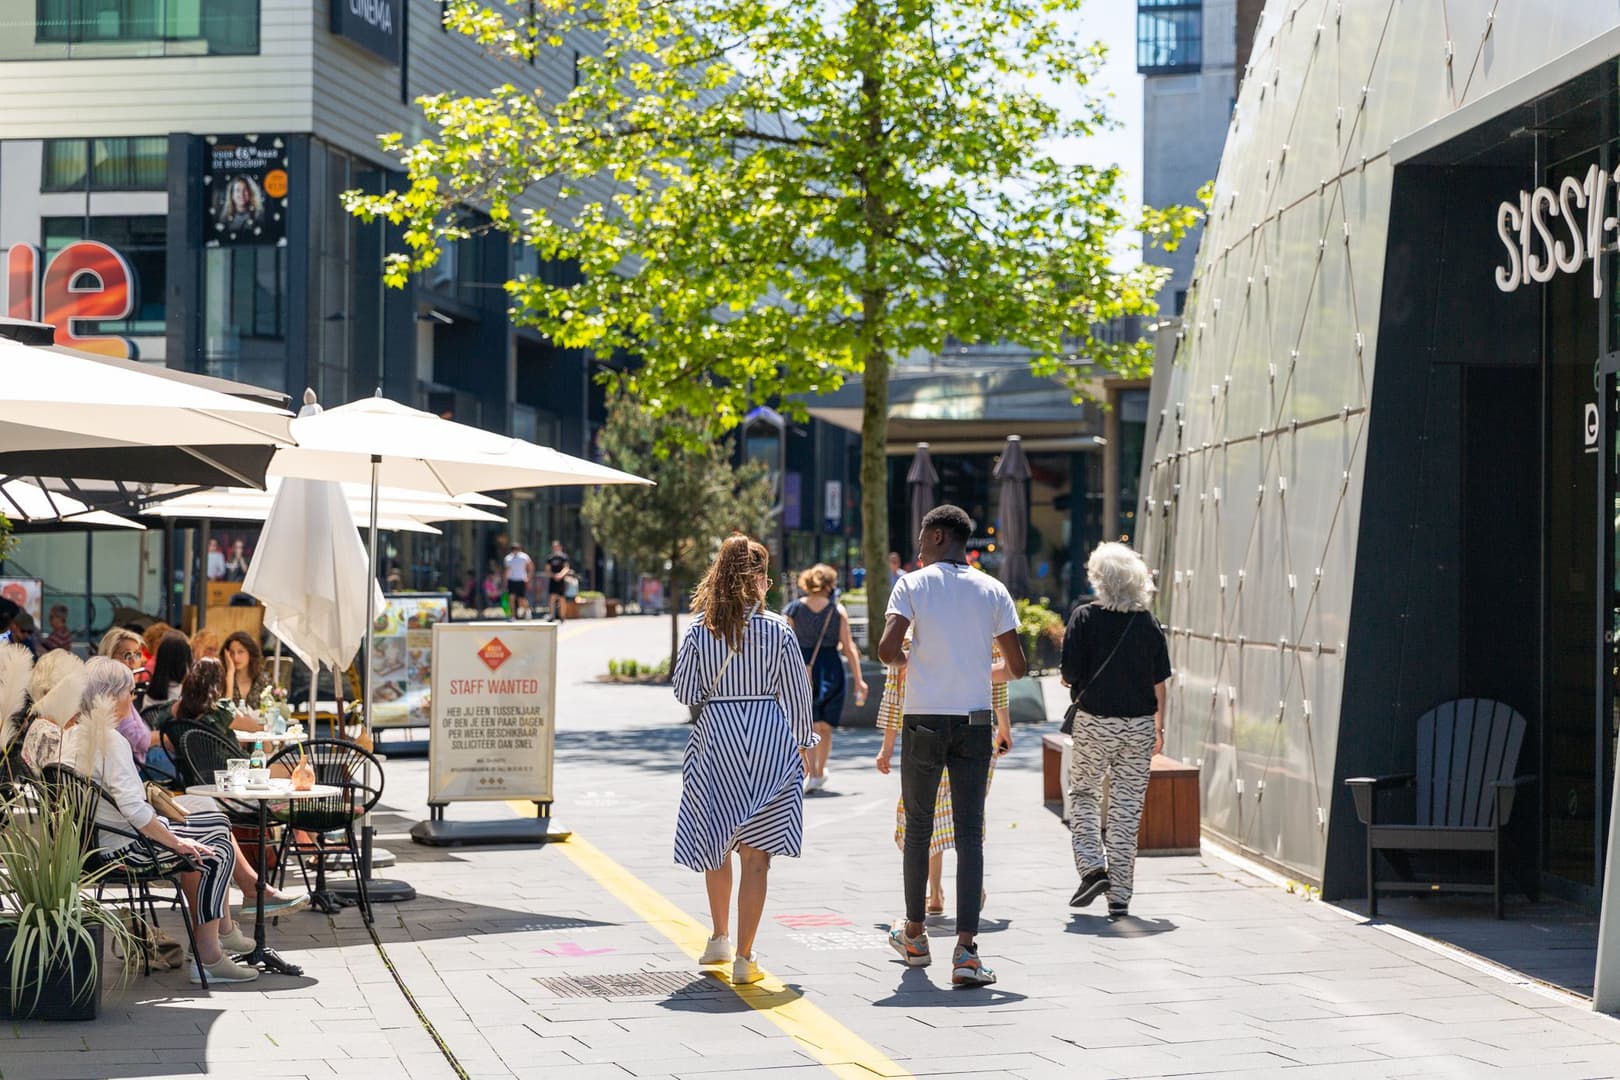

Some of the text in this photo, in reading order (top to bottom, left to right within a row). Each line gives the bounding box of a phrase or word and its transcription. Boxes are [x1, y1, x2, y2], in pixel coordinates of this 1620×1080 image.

[450, 679, 538, 695] STAFF WANTED
[447, 706, 462, 717] HEB
[476, 706, 490, 716] EEN
[493, 705, 541, 716] TUSSENJAAR
[442, 717, 544, 728] OF BEN JE EEN PAAR DAGEN
[448, 728, 538, 739] PER WEEK BESCHIKBAAR
[451, 739, 533, 750] SOLLICITEER DAN SNEL
